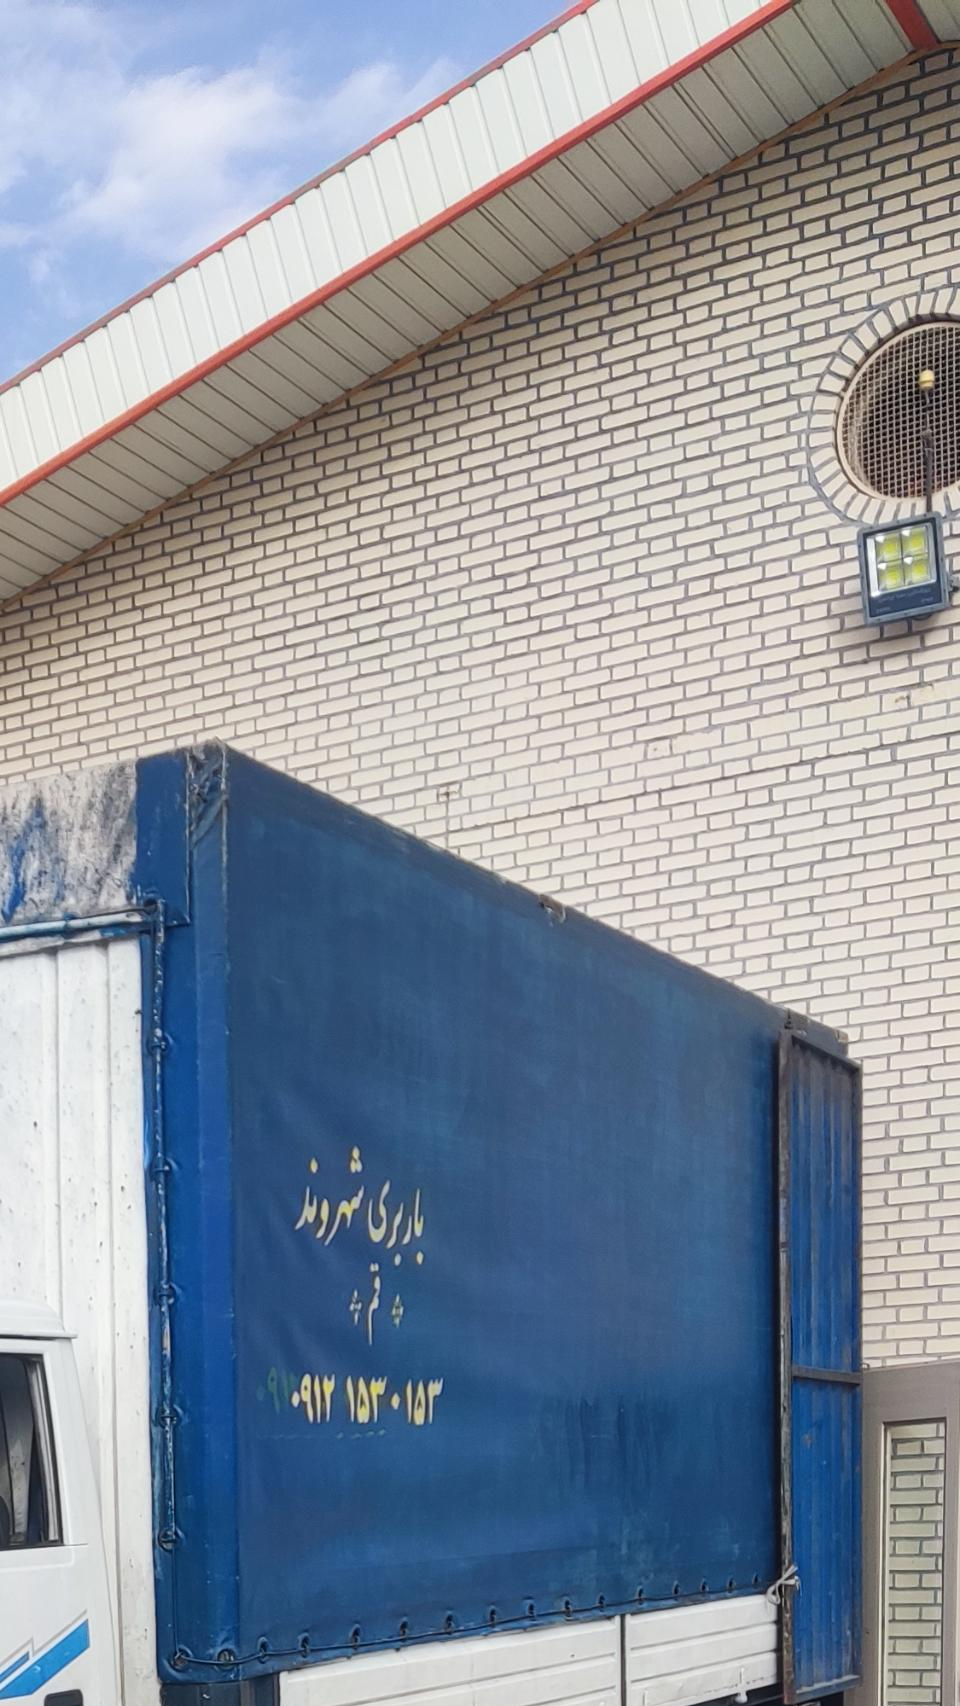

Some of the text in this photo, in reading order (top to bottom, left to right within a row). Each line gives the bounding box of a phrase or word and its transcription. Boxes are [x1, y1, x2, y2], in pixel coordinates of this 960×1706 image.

[295, 1146, 425, 1265] باربری شهروند
[368, 1263, 382, 1346] قم
